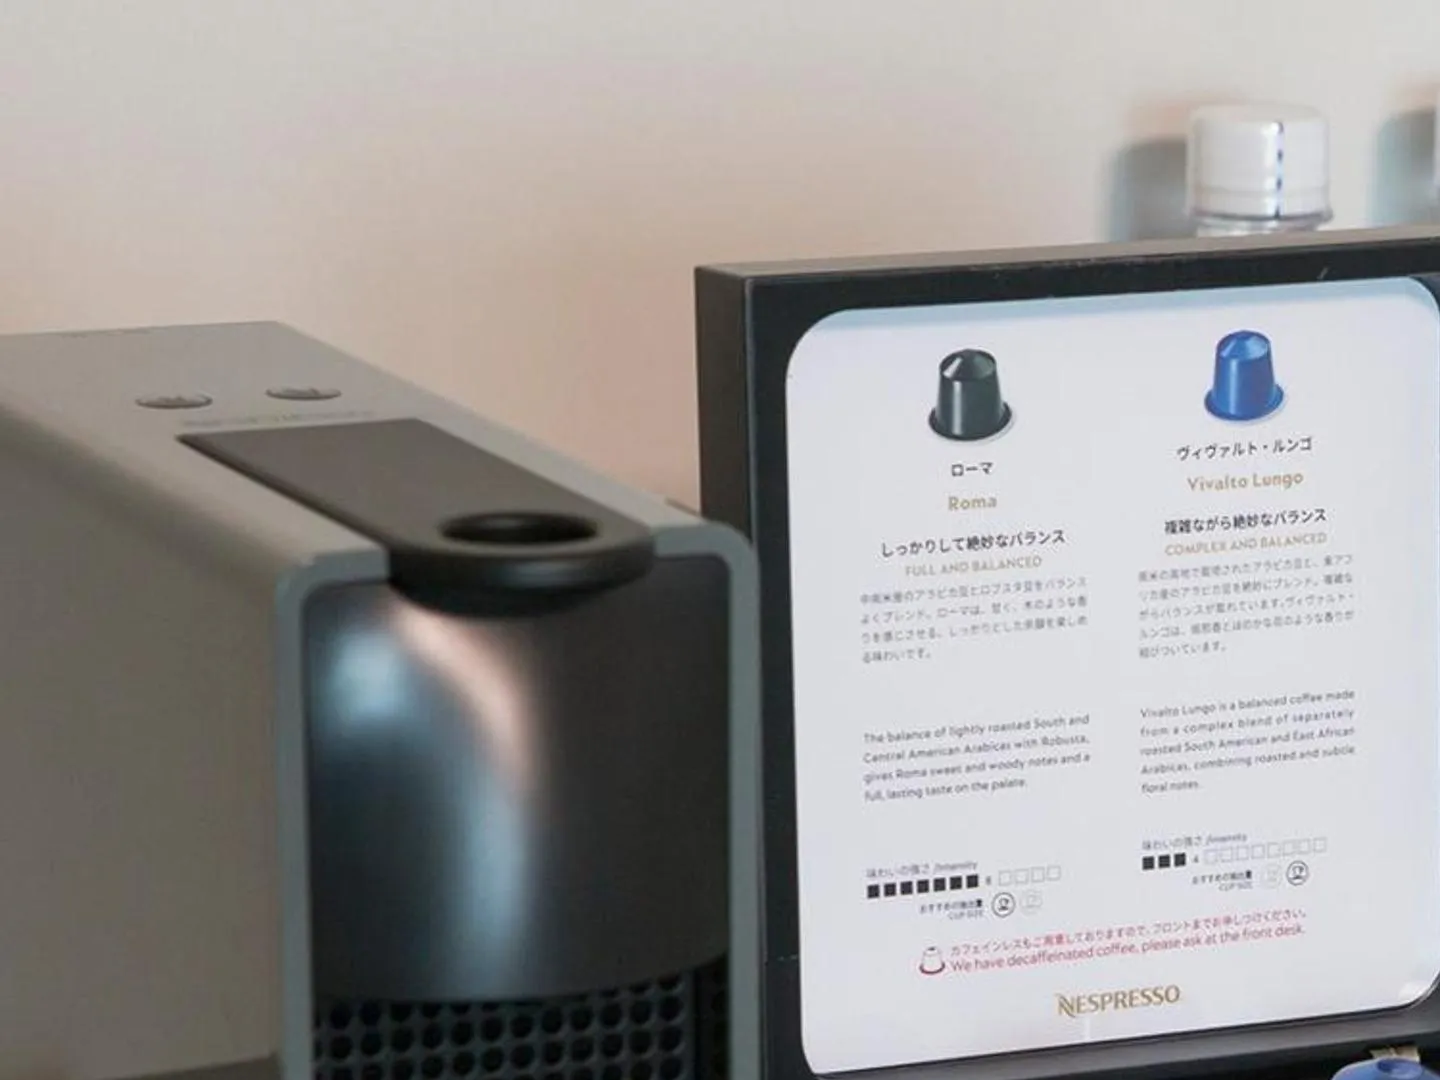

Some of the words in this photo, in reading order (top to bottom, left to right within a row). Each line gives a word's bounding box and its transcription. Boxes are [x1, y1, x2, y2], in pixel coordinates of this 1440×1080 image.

[951, 462, 993, 476] ローマ
[1187, 475, 1247, 491] Vivalto
[1253, 472, 1303, 489] Lungo
[948, 496, 997, 511] Roma
[882, 530, 1066, 557] しっかりして絶妙なバランス
[1165, 540, 1226, 556] COMPLEX
[1231, 538, 1257, 551] AND
[1261, 533, 1327, 549] BALANCED
[905, 563, 936, 577] FULL
[940, 560, 969, 574] AND
[972, 556, 1042, 572] BALANCED
[1140, 706, 1179, 718] Vivalto
[1182, 704, 1216, 718] Lungo
[1219, 702, 1227, 712] is
[1239, 696, 1287, 709] balanced
[1289, 693, 1322, 705] coffee
[1325, 690, 1355, 701] made
[864, 732, 884, 744] The
[887, 730, 930, 743] balance
[934, 727, 946, 738] of
[949, 723, 984, 738] lightly
[988, 720, 1030, 733] roasted
[1035, 716, 1065, 730] South
[1069, 714, 1089, 726] and
[1140, 726, 1168, 737] from
[1183, 721, 1233, 735] complex
[1238, 716, 1272, 728] blend
[1276, 713, 1288, 725] of
[1292, 709, 1354, 724] separately
[863, 750, 904, 764] Central
[909, 746, 961, 761] American
[965, 742, 1010, 754] Arabicas
[1014, 738, 1038, 749] with
[1041, 734, 1089, 747] Robusta,
[1140, 743, 1181, 755] roasted
[1184, 741, 1214, 753] South
[1219, 736, 1268, 749] American
[1271, 733, 1289, 743] and
[1293, 731, 1315, 742] East
[1318, 727, 1355, 739] African
[863, 771, 893, 785] gives
[896, 767, 926, 779] Roma
[930, 765, 962, 777] sweet
[966, 761, 985, 772] and
[989, 758, 1024, 771] woody
[1028, 755, 1057, 767] notes
[1061, 753, 1080, 764] and
[864, 789, 885, 802] full,
[887, 787, 922, 800] lasting
[926, 784, 953, 796] taste
[955, 784, 968, 793] on
[971, 780, 988, 791] the
[991, 777, 1027, 791] palate.
[951, 959, 971, 972] We
[975, 956, 1004, 969] have
[1008, 948, 1093, 967] decaffeinated
[1097, 942, 1139, 958] coffee,
[1142, 936, 1180, 953] please
[1183, 934, 1201, 947] ask
[1205, 934, 1216, 945] at
[1220, 930, 1239, 943] the
[1242, 928, 1272, 941] front
[1277, 923, 1305, 937] desk.
[1056, 985, 1180, 1017] NESPRESSO
